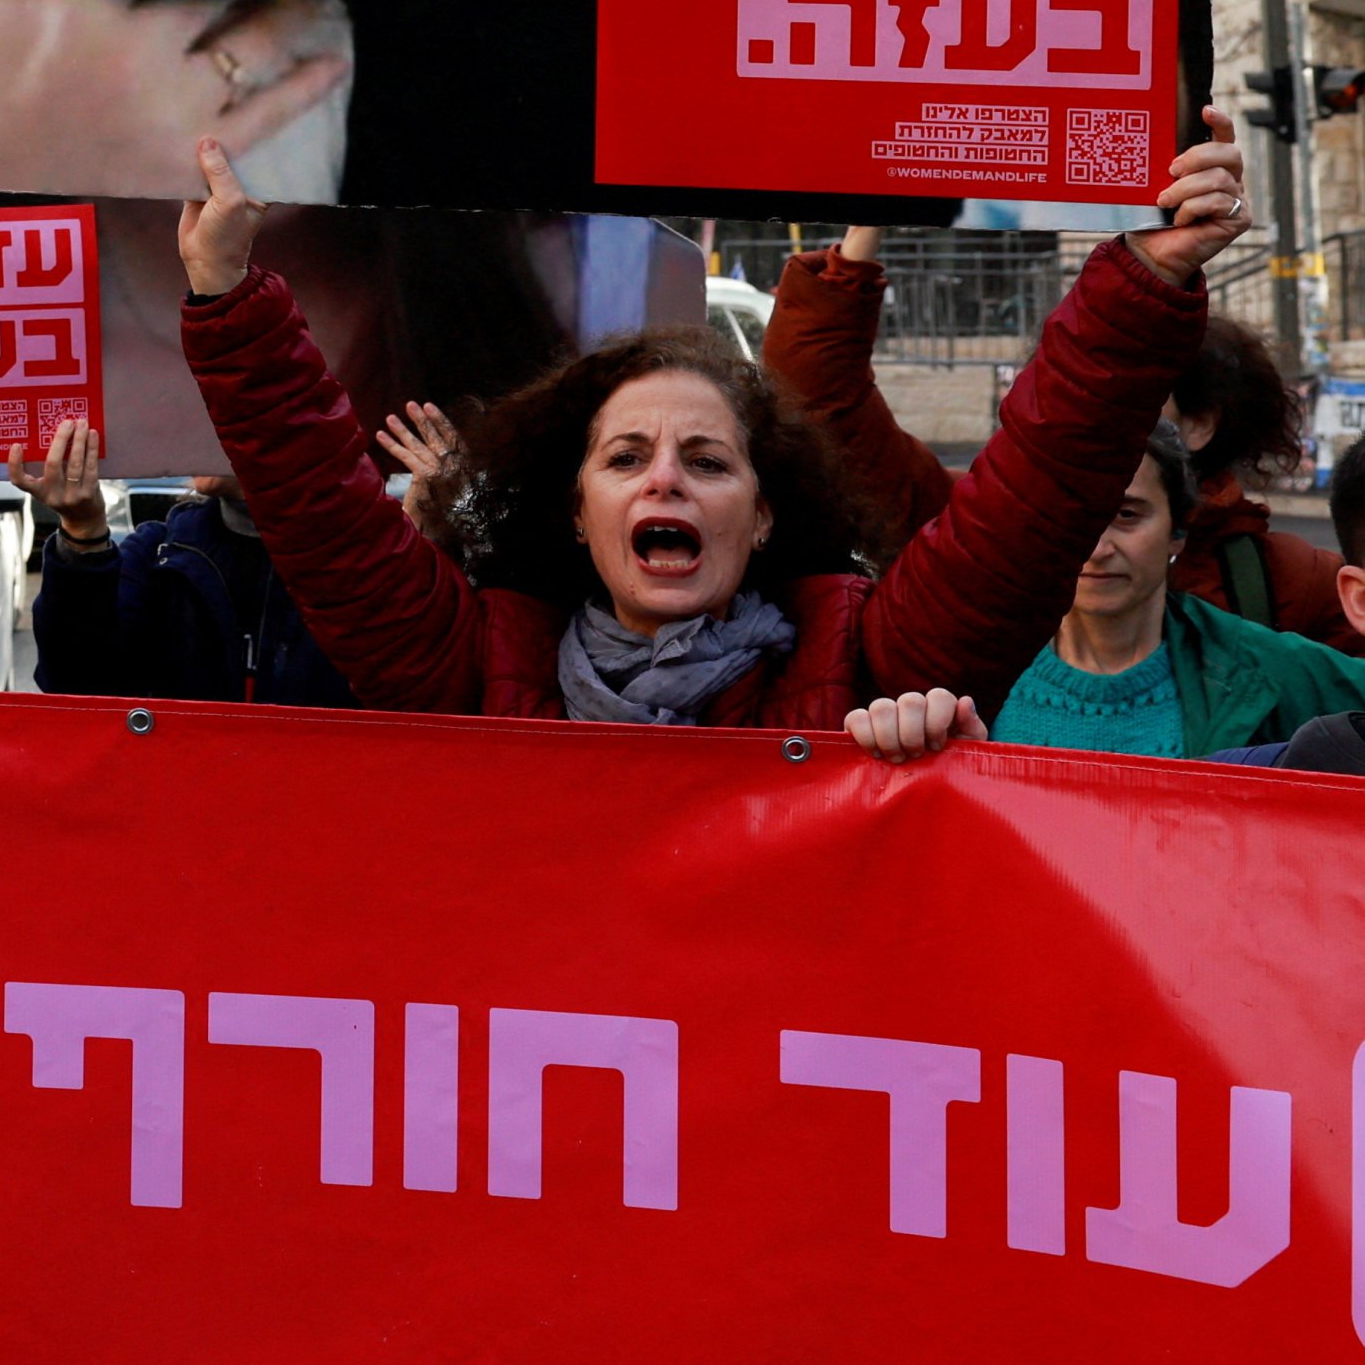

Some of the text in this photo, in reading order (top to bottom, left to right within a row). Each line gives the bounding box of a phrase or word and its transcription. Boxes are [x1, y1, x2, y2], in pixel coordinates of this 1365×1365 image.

[925, 105, 1047, 123] הצטרפו אלינו
[899, 125, 1046, 142] למאבק להחזרת
[874, 144, 1046, 163] החטופות והחטופים
[886, 167, 1047, 183] @WOMENDEMANDLIFE
[4, 982, 679, 1212] חורף
[780, 1030, 1292, 1289] עוד
